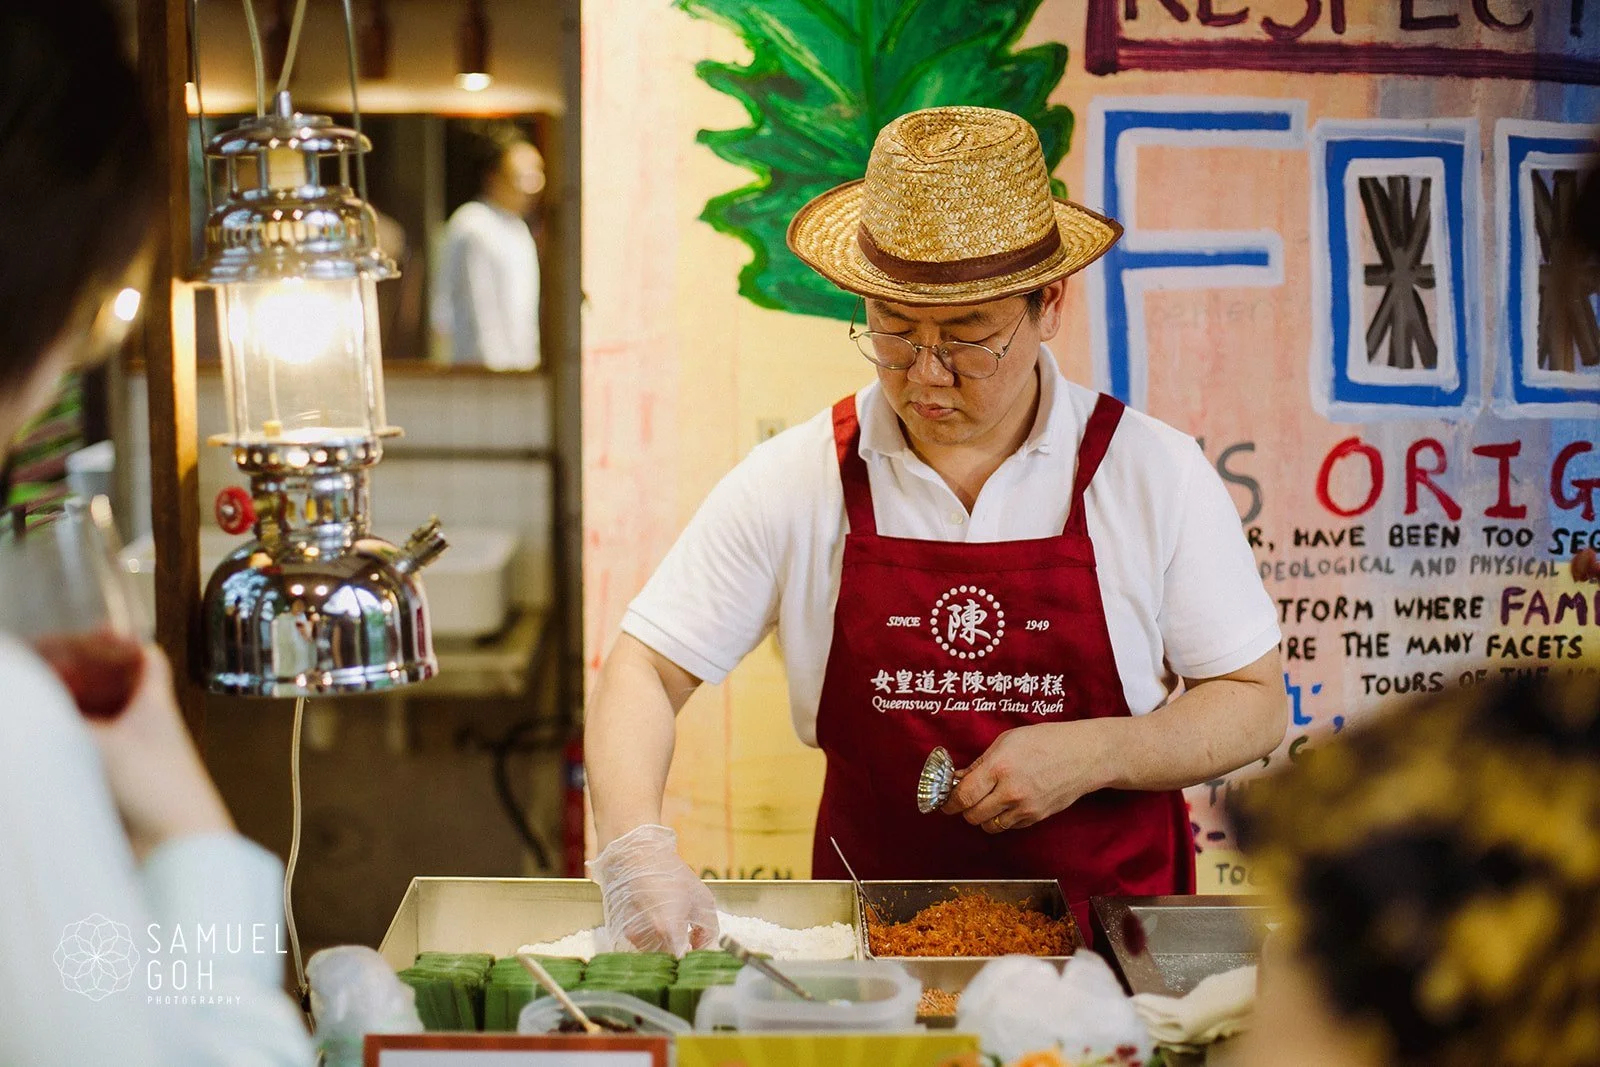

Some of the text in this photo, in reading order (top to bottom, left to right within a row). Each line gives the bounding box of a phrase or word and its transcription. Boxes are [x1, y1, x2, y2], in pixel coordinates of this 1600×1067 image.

[1315, 436, 1600, 521] ORIG
[1294, 527, 1365, 547] HAVE
[1389, 524, 1460, 548] BEEN
[1482, 525, 1534, 548] TOO
[1410, 557, 1457, 578] AND
[1470, 555, 1559, 579] PHYSICAL
[947, 598, 991, 645] 陳
[1278, 596, 1374, 623] TFORM
[1394, 596, 1484, 621] WHERE
[886, 616, 1050, 631] SINCE 1949
[1279, 631, 1583, 660] RE THE MANY FACETS
[870, 669, 1066, 697] 女皇道老陳嘟嘟糕
[1361, 671, 1445, 694] TOURS
[872, 695, 1064, 716] Queensway Lau Tan Tutu Kueh
